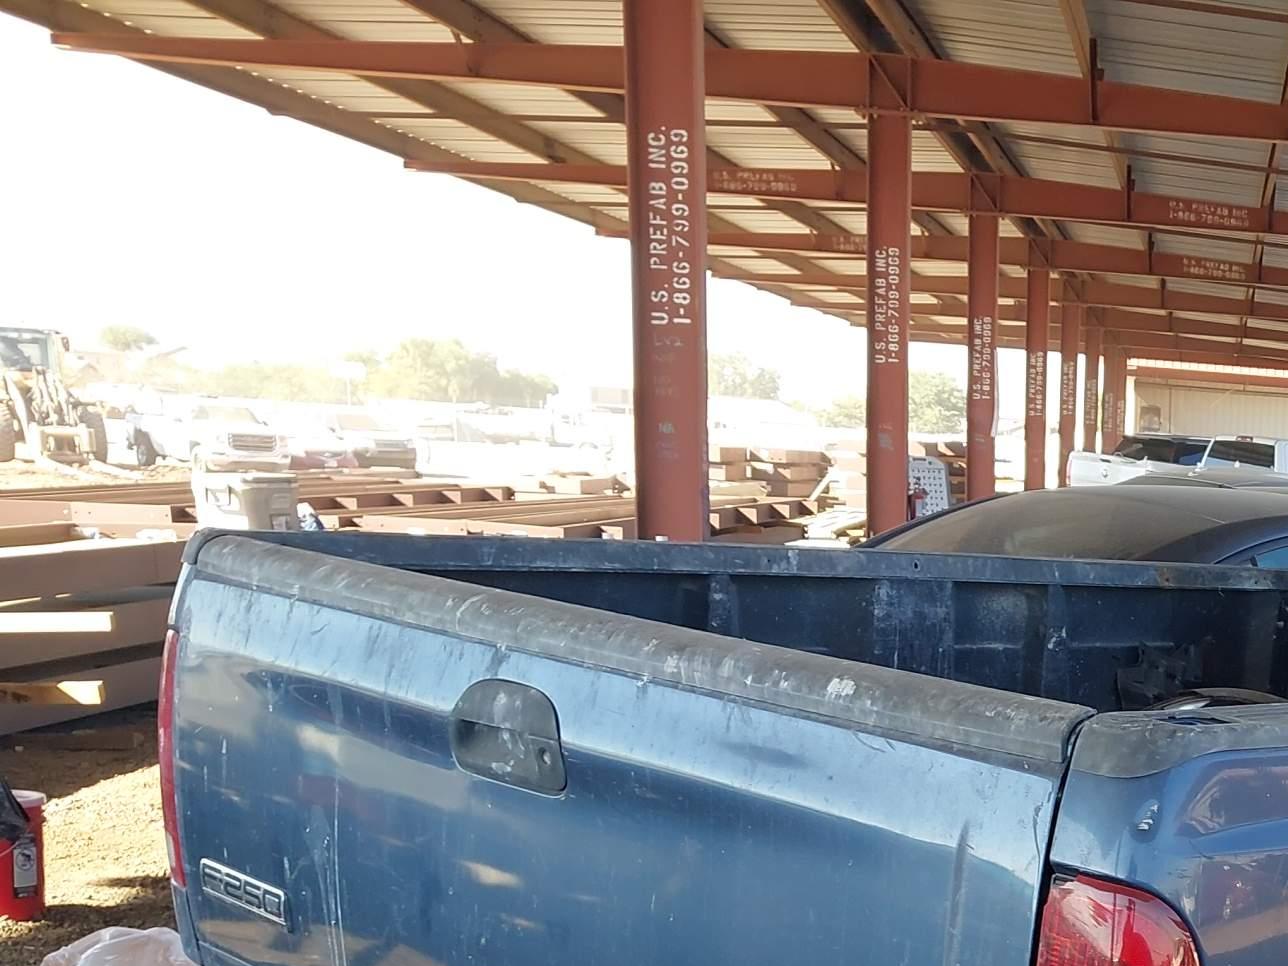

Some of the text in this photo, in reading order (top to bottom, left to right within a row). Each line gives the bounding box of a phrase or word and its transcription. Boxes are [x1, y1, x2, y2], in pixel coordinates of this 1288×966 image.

[648, 126, 669, 325] U.S. PREFAB INC.
[670, 129, 692, 325] 1-866-799-0969
[874, 278, 887, 331] PREFAB
[875, 338, 886, 363] U.S.
